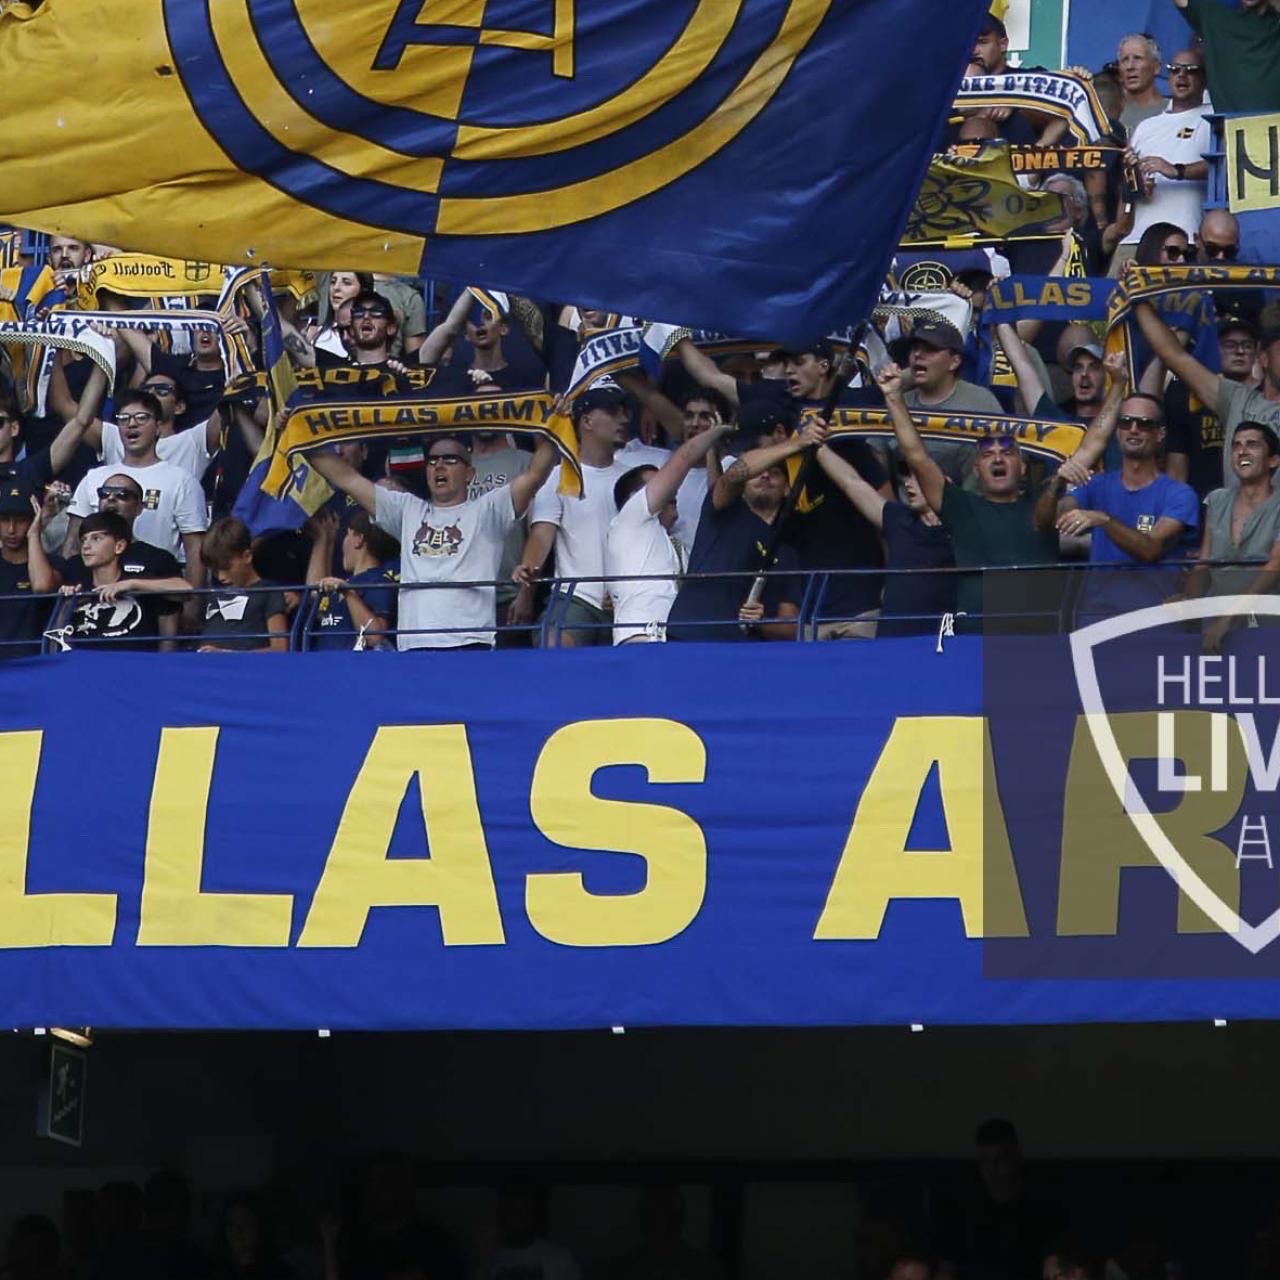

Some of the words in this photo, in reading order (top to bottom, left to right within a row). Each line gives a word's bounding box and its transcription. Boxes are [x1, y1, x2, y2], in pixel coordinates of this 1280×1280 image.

[1012, 151, 1060, 171] ONA
[1066, 150, 1106, 170] F.C.
[306, 408, 439, 434] HELLAS
[453, 397, 553, 427] ARMY
